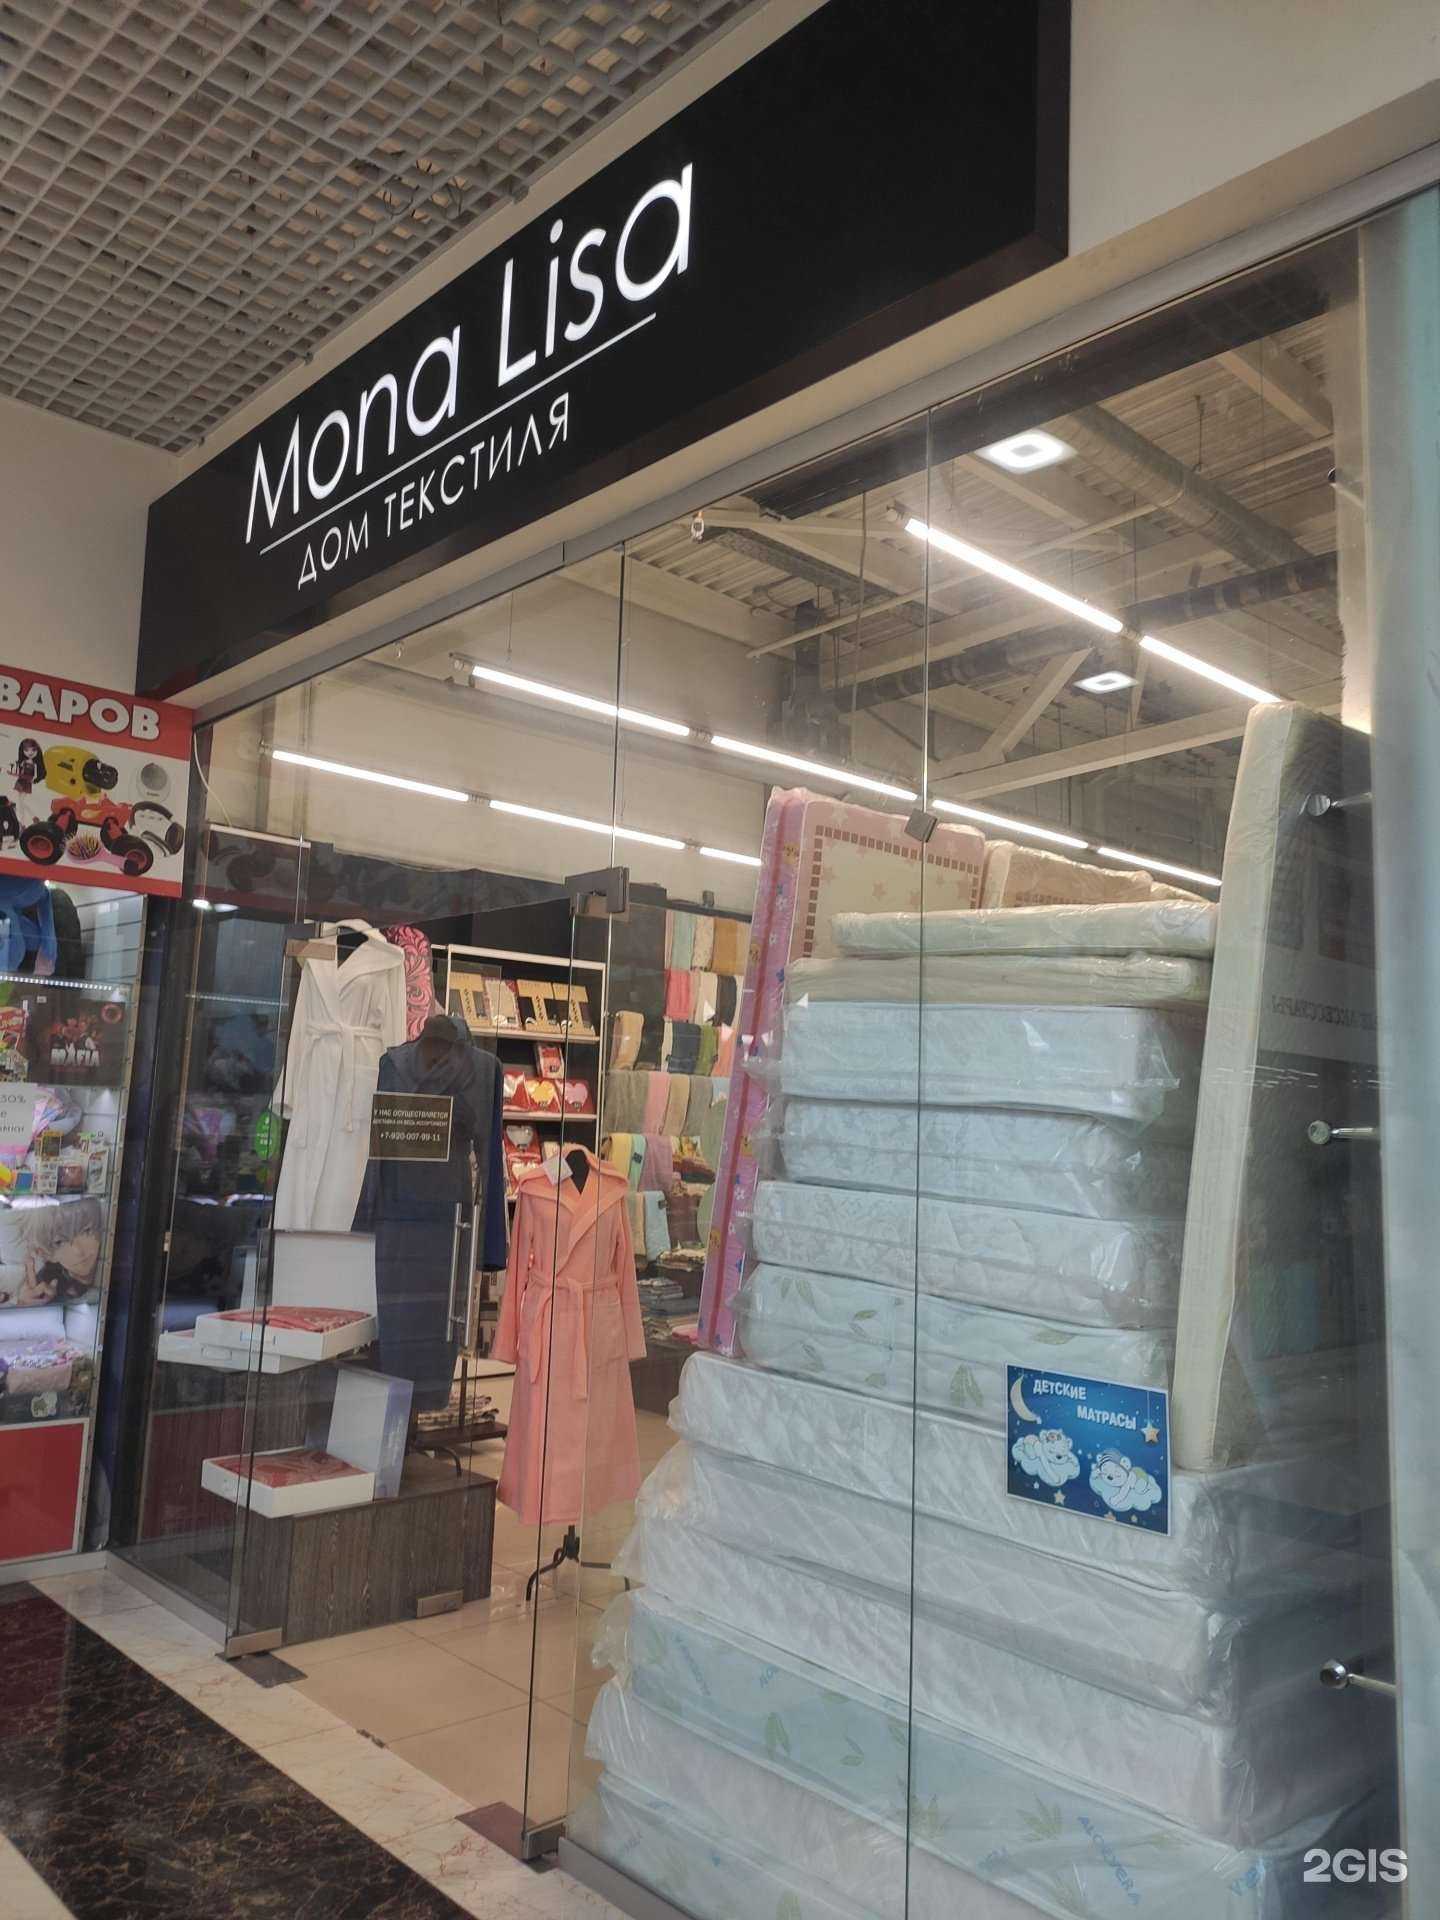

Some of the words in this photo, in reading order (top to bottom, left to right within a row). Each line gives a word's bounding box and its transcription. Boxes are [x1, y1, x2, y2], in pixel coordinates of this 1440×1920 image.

[245, 325, 461, 544] Mona
[498, 162, 693, 387] Lisa
[298, 511, 368, 590] ДОМ
[384, 392, 570, 537] ТЕКСТИЛЯ
[0, 675, 159, 740] ВАРОВ
[50, 1044, 101, 1067] MAFIA
[1033, 1379, 1087, 1400] ДЕТСКИЕ
[1077, 1405, 1137, 1430] МАТРАСЫ
